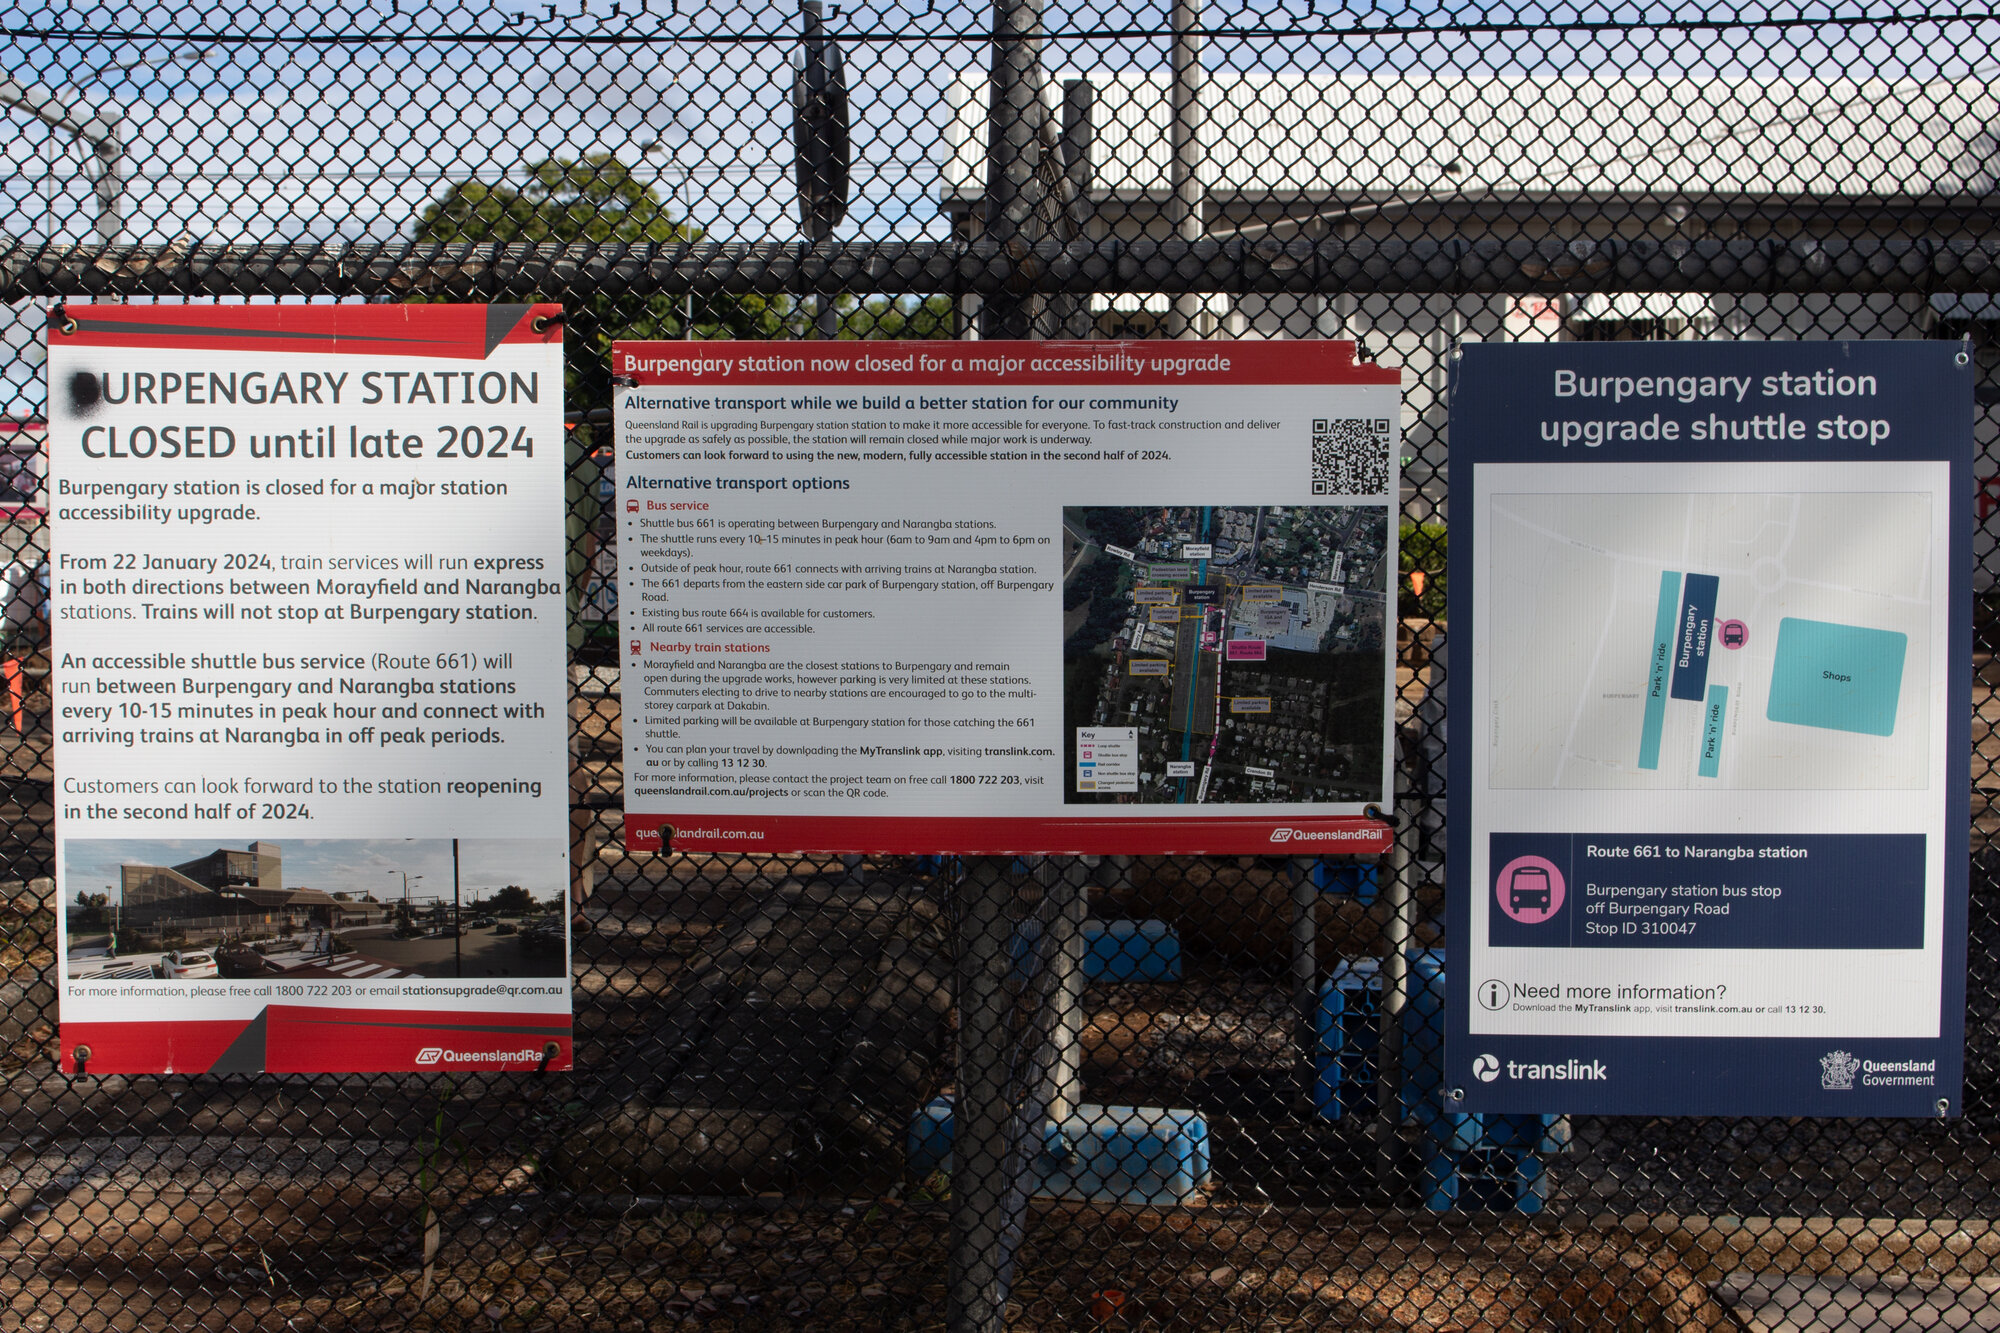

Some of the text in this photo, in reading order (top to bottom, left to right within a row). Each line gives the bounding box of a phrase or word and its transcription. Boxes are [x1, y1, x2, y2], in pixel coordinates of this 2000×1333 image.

[624, 351, 1230, 376] Burpengary station now closed for a major accessibility upgrade
[76, 371, 537, 404] URPENGARY STATION
[1554, 367, 1876, 402] Burpengary station
[624, 395, 1178, 412] Alternative transport while we build a better station for our community
[1541, 412, 1889, 446] upgrade shuttle stop
[81, 425, 532, 458] CLOSED until late 2024
[59, 478, 506, 499] Burpengary station is closed for a major station
[626, 475, 711, 489] Alternative
[715, 476, 787, 492] transport
[792, 476, 849, 492] options
[646, 499, 708, 510] Bus service
[639, 518, 996, 530] Shuttle bus 661 is operating between Burpengary and Narangba stations.
[60, 553, 544, 574] From 22 January 2024, train services will run express
[60, 602, 536, 624] stations. Trains will not stop at Burpengary station.
[642, 607, 874, 619] Existing bus route 664 is available for customers.
[1679, 604, 1698, 667] Burpengary
[1696, 620, 1708, 656] station
[650, 641, 770, 654] Nearby train stations
[1652, 676, 1662, 697] Park
[1657, 643, 1666, 660] ride
[1822, 670, 1851, 682] Shops
[1081, 731, 1095, 739] Key
[1705, 737, 1715, 758] Park
[1710, 704, 1720, 722] ride
[1292, 829, 1382, 840] QueenslandRail
[1587, 845, 1807, 860] Route 661 to Narangba station
[1586, 883, 1781, 899] Burpengary station bus stop
[1585, 901, 1729, 916] off Burpengary Road
[1585, 921, 1696, 936] Stop ID 310047
[68, 984, 562, 998] For more information, please free call 1800 722 203 or email stationsupgrade@qr.com.au
[1513, 982, 1726, 999] Need more information?
[1512, 1002, 1555, 1011] Download
[1558, 1003, 1572, 1011] the
[1574, 1003, 1630, 1013] MyTranslink
[1674, 1004, 1752, 1012] translink.com.au
[1785, 1005, 1796, 1013] 13
[1799, 1005, 1809, 1013] 12
[1812, 1005, 1825, 1013] 30.
[443, 1049, 548, 1062] QueenslandRa
[1506, 1059, 1606, 1079] translink
[1862, 1059, 1934, 1072] Queensland
[1862, 1073, 1934, 1085] Government
